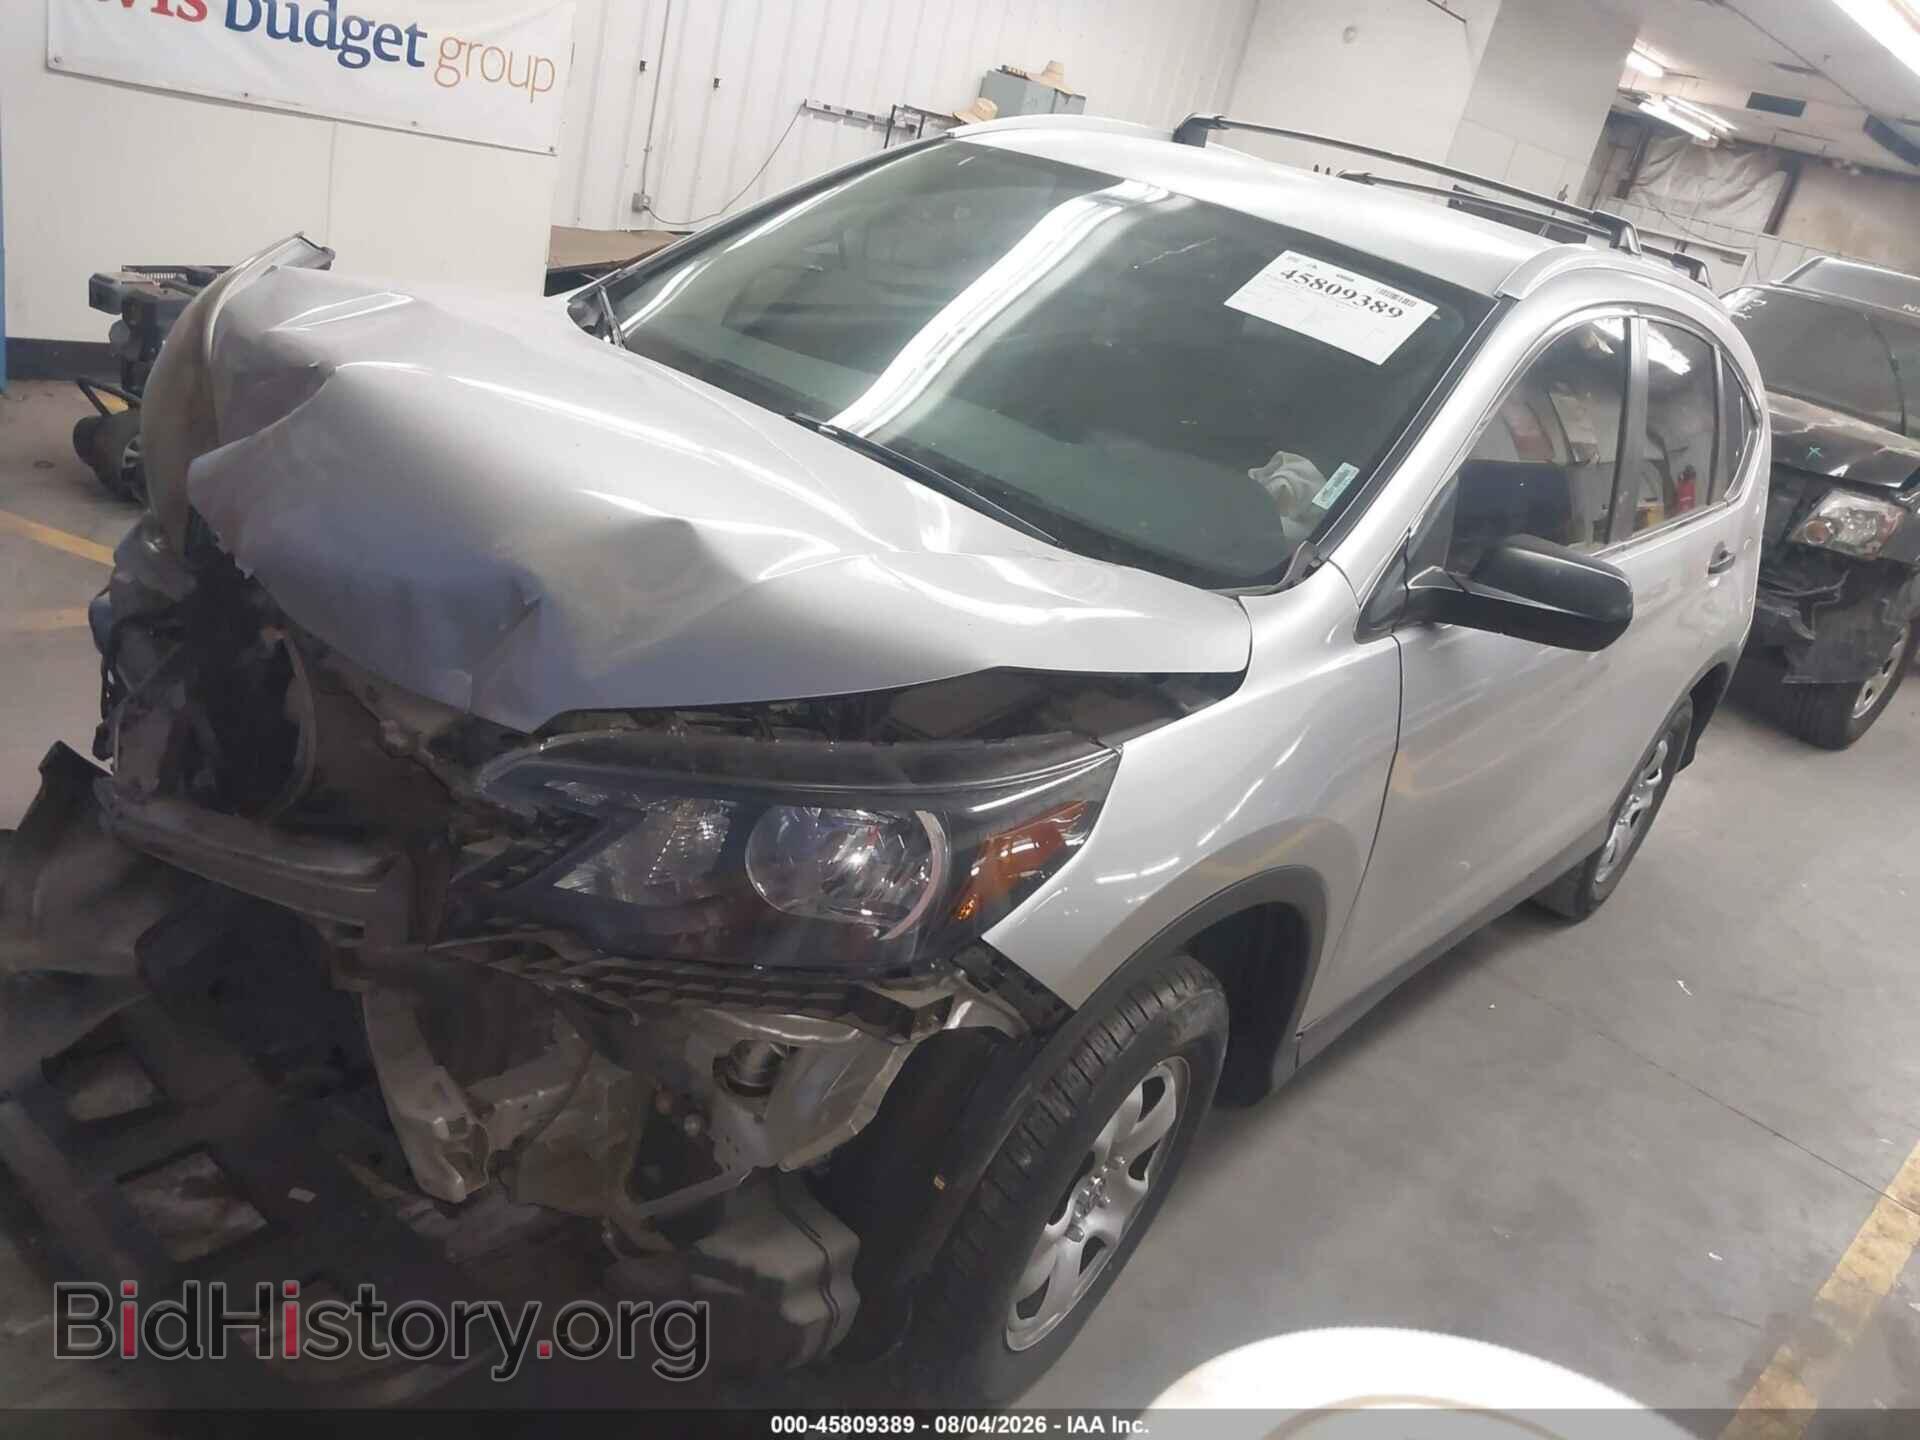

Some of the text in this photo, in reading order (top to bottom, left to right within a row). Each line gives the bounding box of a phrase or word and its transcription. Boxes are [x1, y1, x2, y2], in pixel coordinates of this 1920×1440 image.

[224, 0, 555, 104] budget group
[1281, 269, 1404, 319] 45809389
